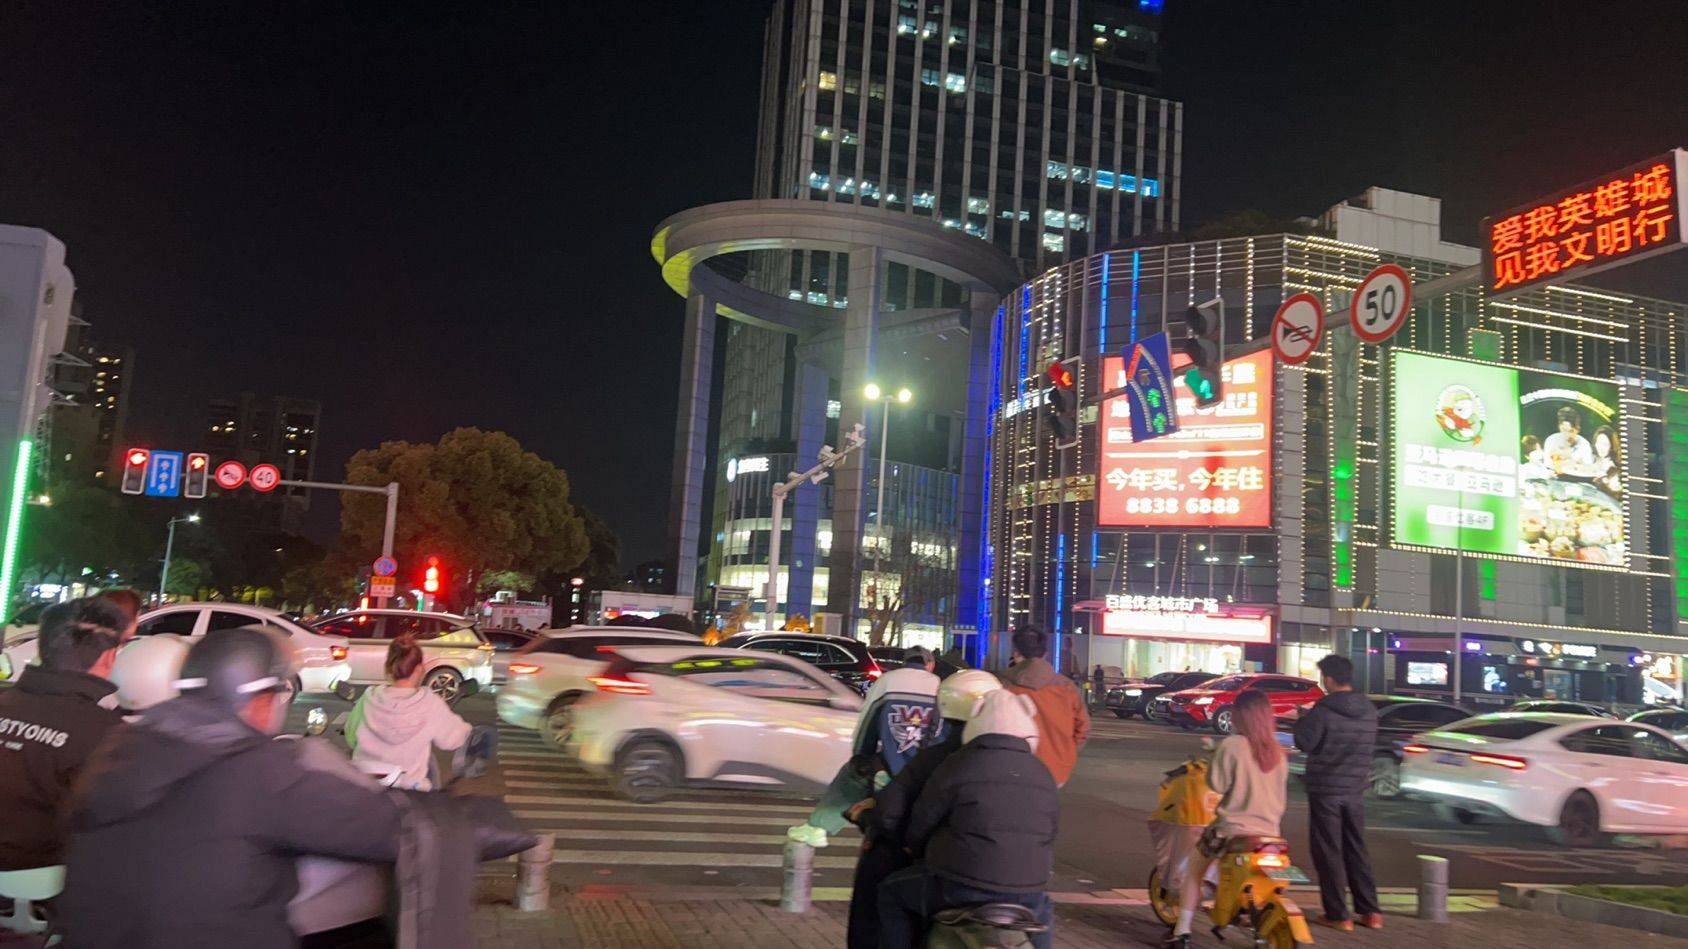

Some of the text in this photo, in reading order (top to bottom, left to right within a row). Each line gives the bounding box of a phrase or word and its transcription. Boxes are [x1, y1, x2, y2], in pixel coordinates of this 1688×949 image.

[1492, 164, 1672, 254] 爱我英雄城
[1493, 204, 1673, 290] 见我文明行
[1366, 284, 1396, 326] 50
[256, 469, 273, 484] 40
[1126, 497, 1241, 514] 8838 6888
